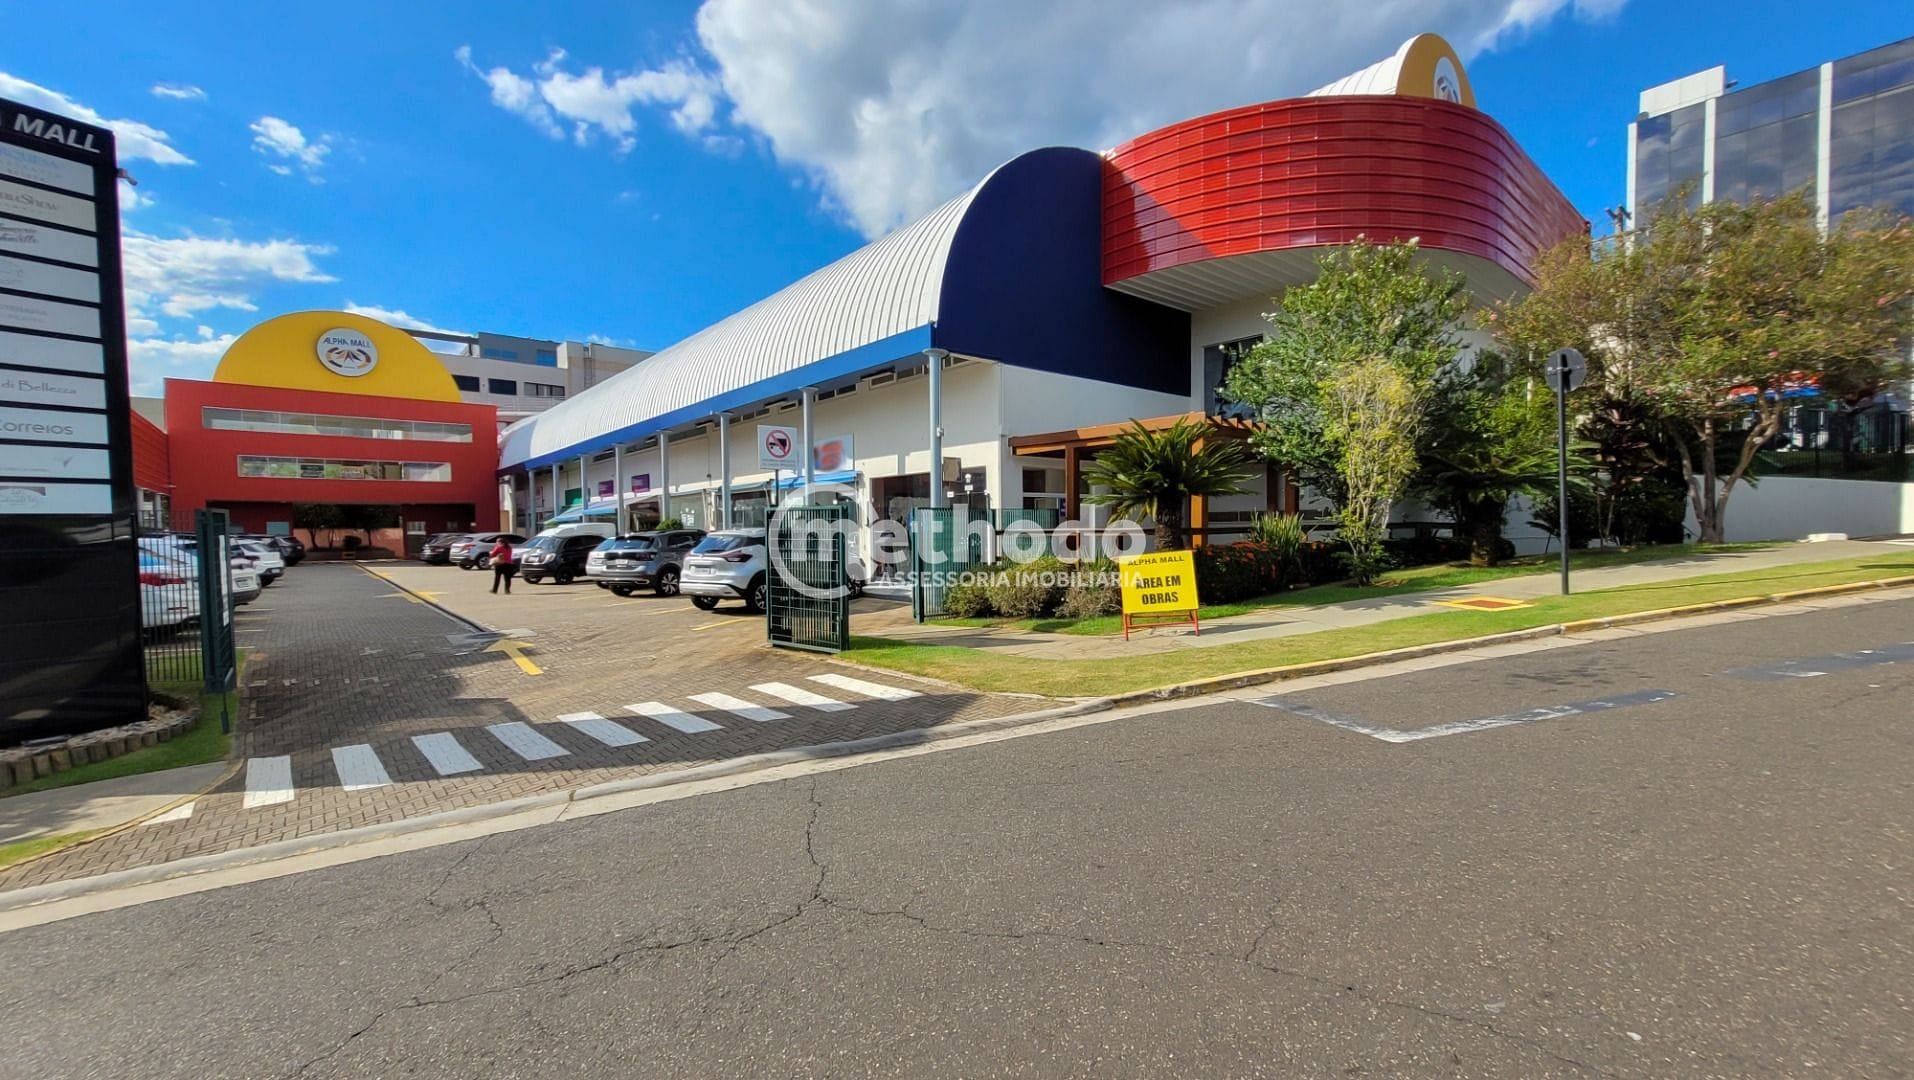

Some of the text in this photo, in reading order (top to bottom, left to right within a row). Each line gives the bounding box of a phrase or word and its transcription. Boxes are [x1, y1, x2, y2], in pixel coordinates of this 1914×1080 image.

[14, 113, 101, 154] MALL
[323, 336, 371, 348] ALPHA MALL
[1165, 575, 1181, 586] EM
[1142, 592, 1178, 605] OBRAS
